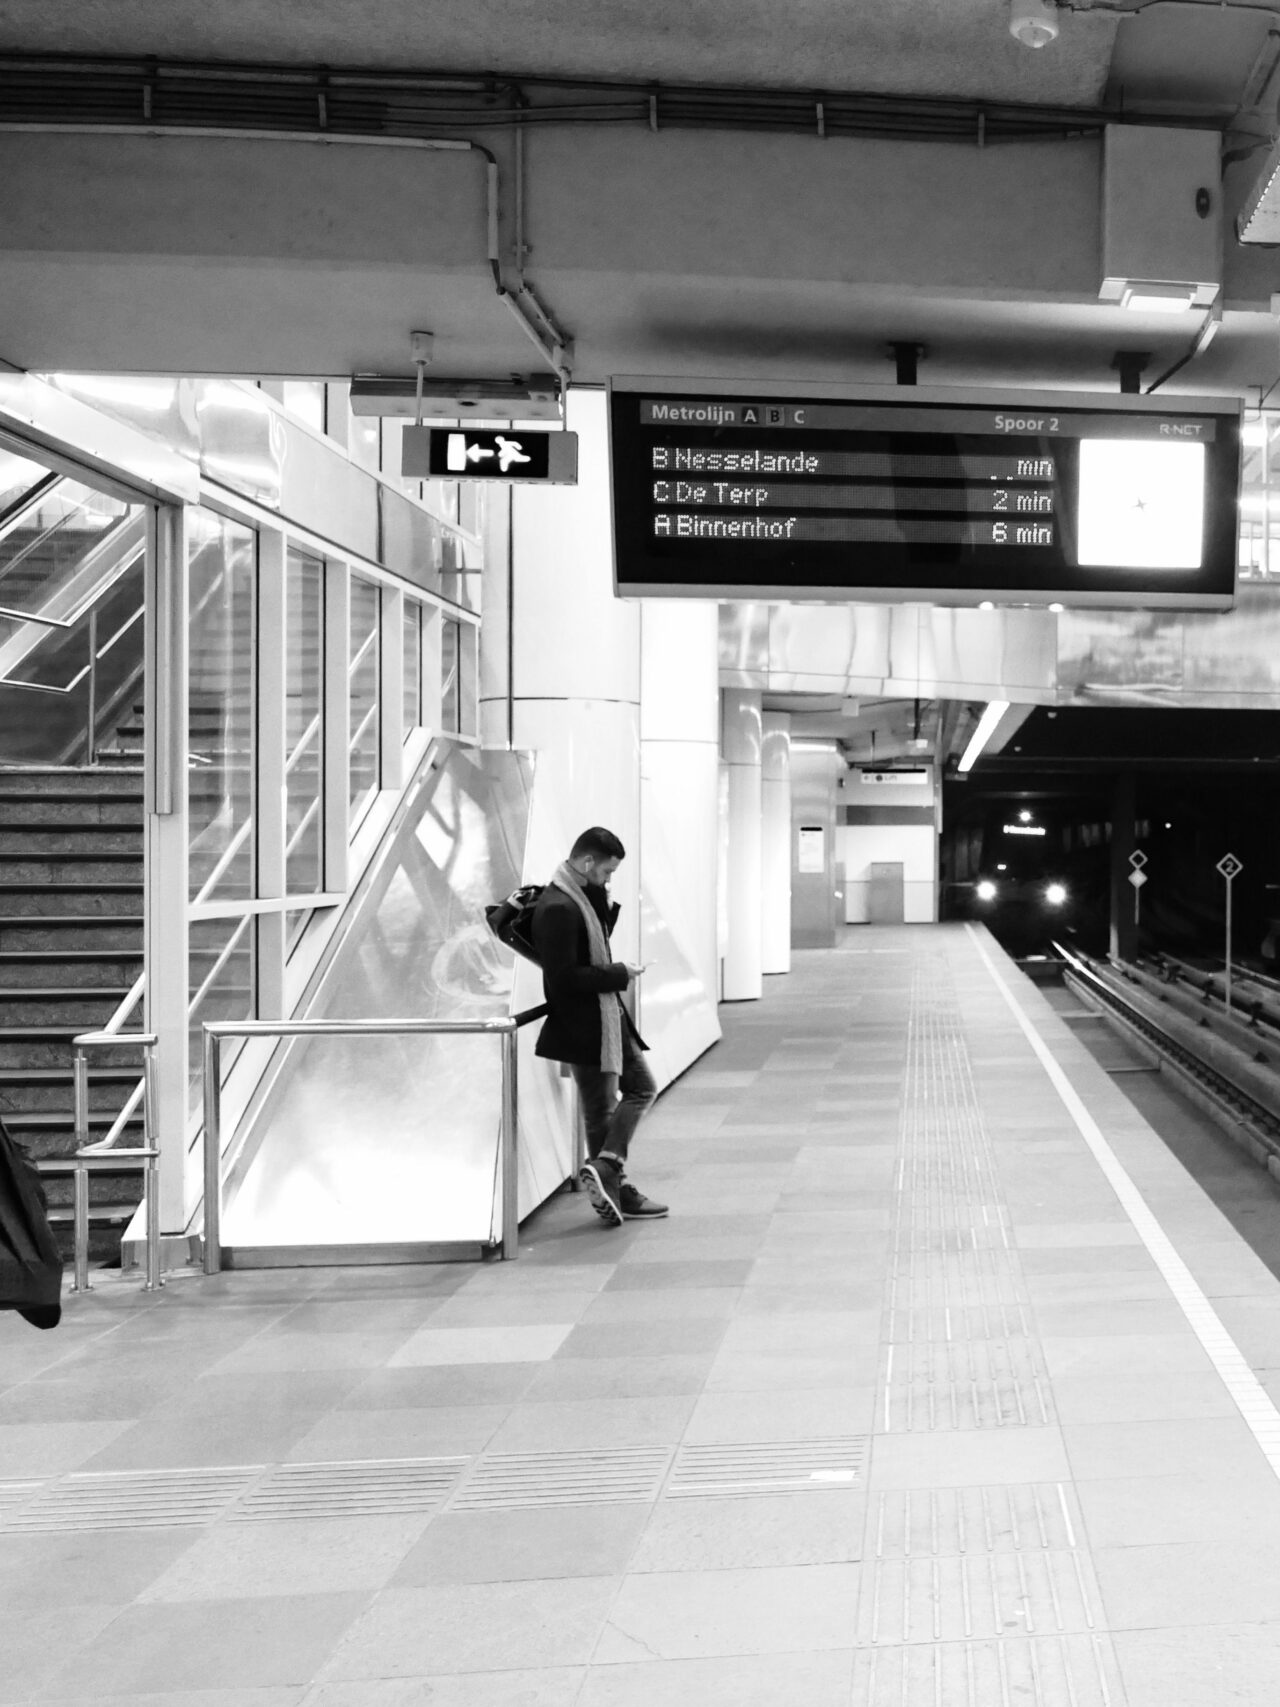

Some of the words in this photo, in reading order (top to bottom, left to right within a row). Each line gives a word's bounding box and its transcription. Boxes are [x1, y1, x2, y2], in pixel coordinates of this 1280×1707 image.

[652, 405, 735, 424] Metrolijn
[744, 409, 757, 422] A
[770, 412, 780, 423] B
[794, 410, 805, 423] C
[995, 415, 1044, 432] Spoor
[1050, 418, 1059, 431] 2
[653, 447, 667, 468] B
[675, 448, 818, 472] Nesselande
[1017, 460, 1052, 476] min
[653, 481, 669, 502] C
[677, 481, 706, 502] De
[713, 482, 768, 507] Terp
[993, 489, 1008, 510] 2
[1017, 490, 1052, 511] min
[655, 514, 670, 535] A
[677, 515, 796, 538] Binnenhof
[993, 522, 1008, 543] 6
[1017, 522, 1051, 544] min
[1225, 861, 1234, 873] 2
